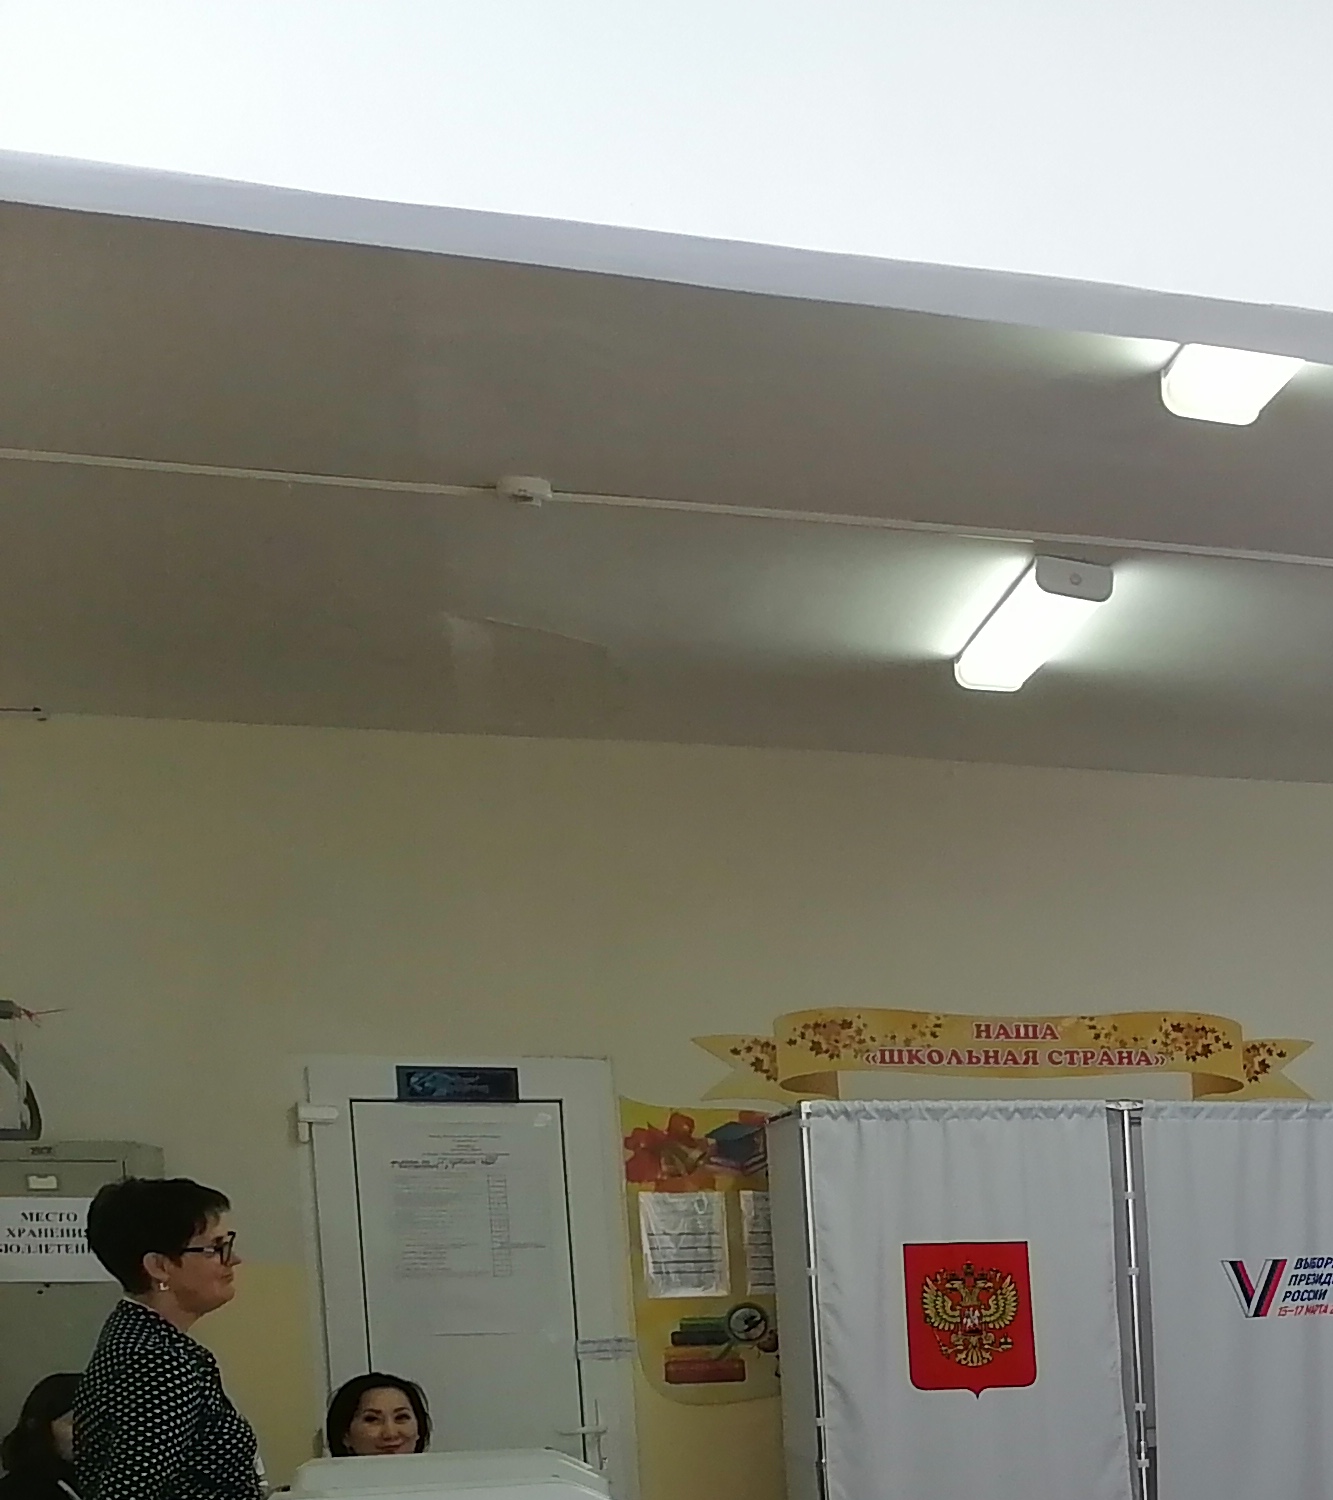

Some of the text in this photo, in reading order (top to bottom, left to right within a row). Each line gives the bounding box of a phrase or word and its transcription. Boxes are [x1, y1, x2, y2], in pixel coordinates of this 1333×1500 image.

[974, 1023, 1060, 1041] НАША
[864, 1048, 1166, 1066] «ШКОЛЬНАЯ СТРАНА»
[21, 1211, 78, 1222] МЕСТО
[1281, 1288, 1328, 1302] РОССИИ
